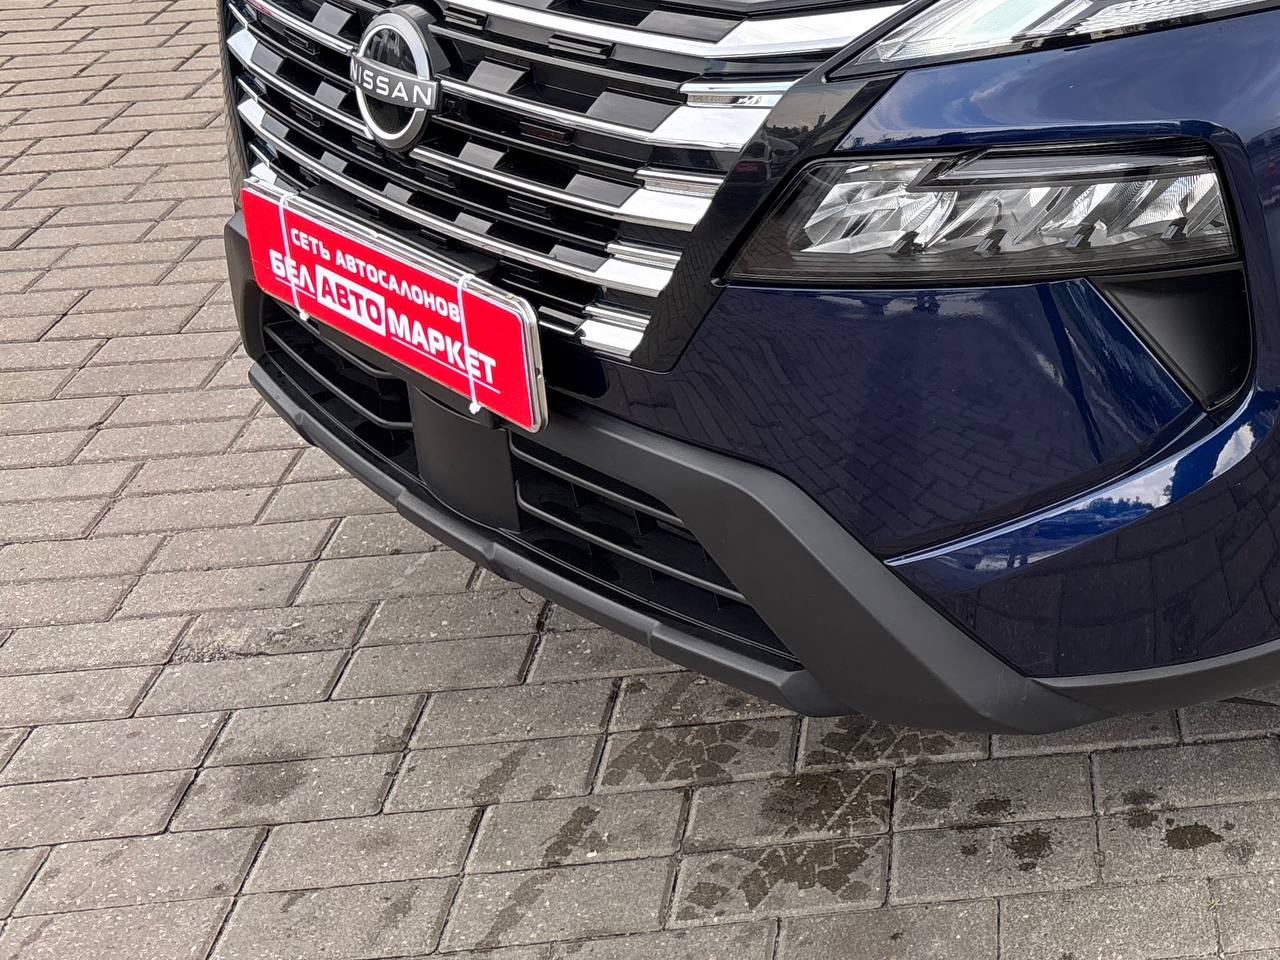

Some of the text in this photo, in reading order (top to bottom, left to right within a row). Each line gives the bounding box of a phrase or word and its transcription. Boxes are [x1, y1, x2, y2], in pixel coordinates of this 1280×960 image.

[351, 58, 432, 106] NISSAN
[290, 228, 461, 324] СЕТЬ АВТОСАЛОНОВ
